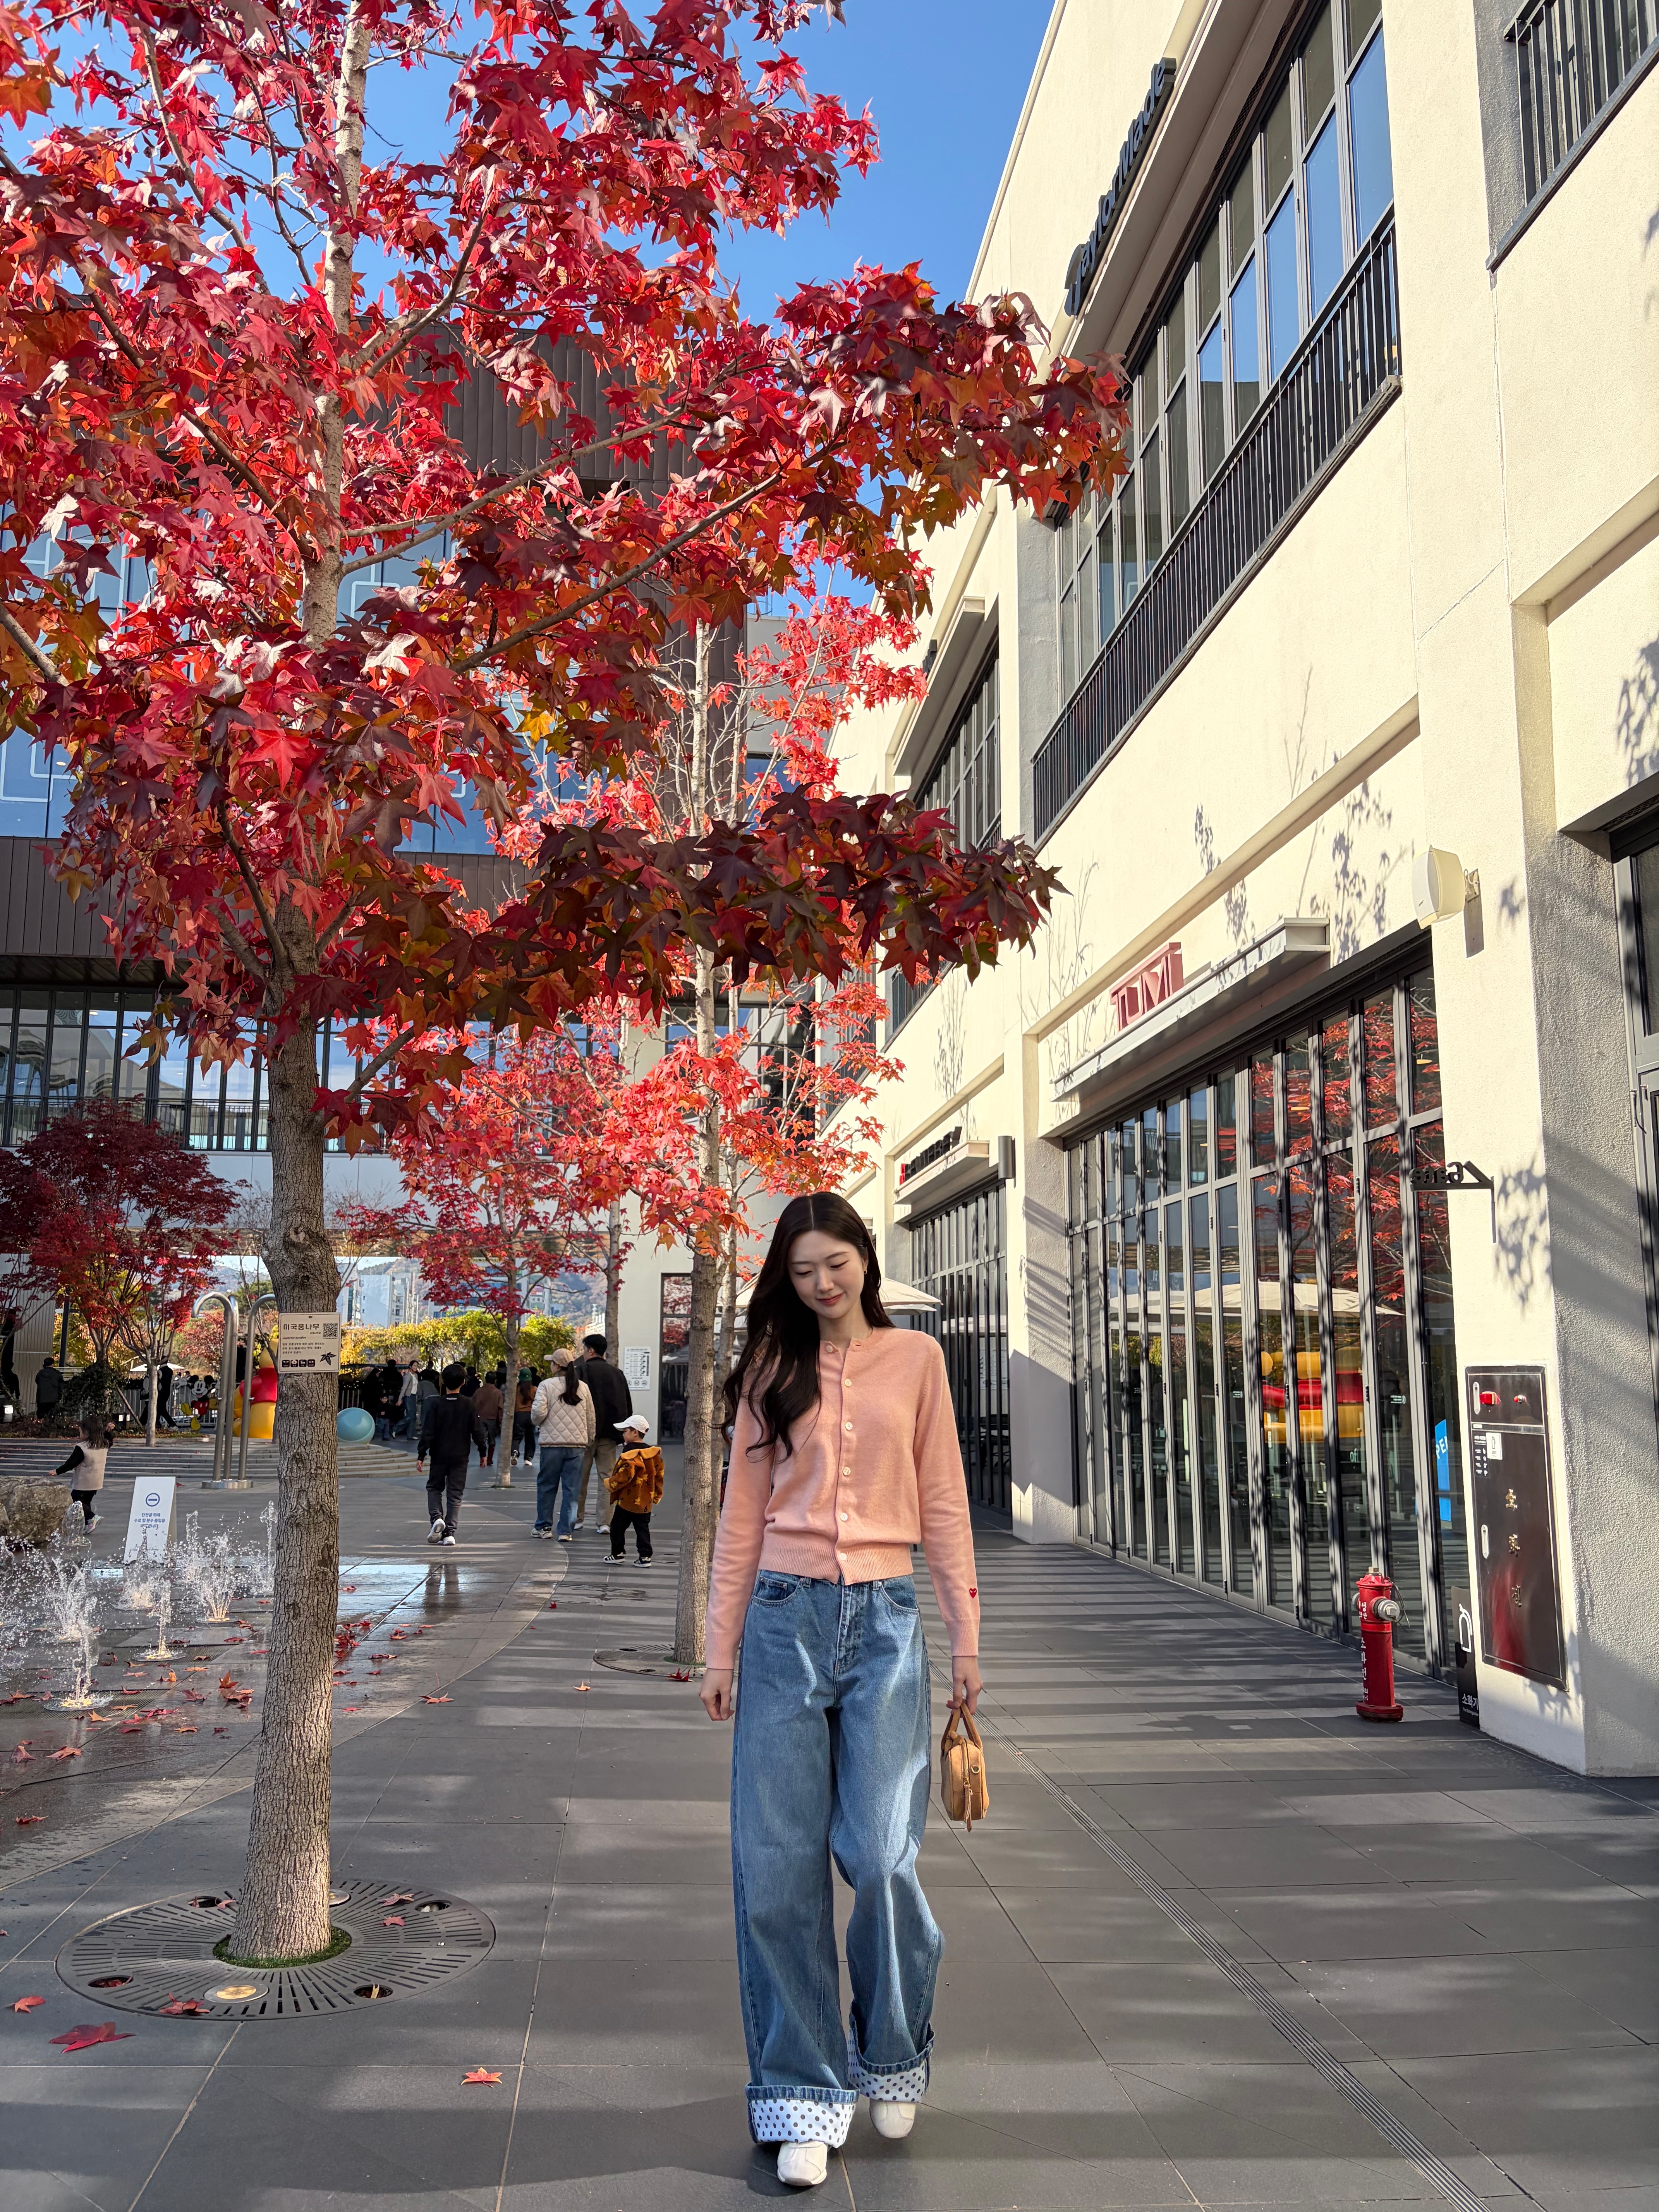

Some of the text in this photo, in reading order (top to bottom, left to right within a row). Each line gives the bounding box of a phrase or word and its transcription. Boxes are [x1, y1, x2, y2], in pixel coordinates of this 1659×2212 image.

[1064, 57, 1176, 317] TaylorMade
[1110, 942, 1184, 1031] TUMI
[1462, 1693, 1479, 1710] 소화기
